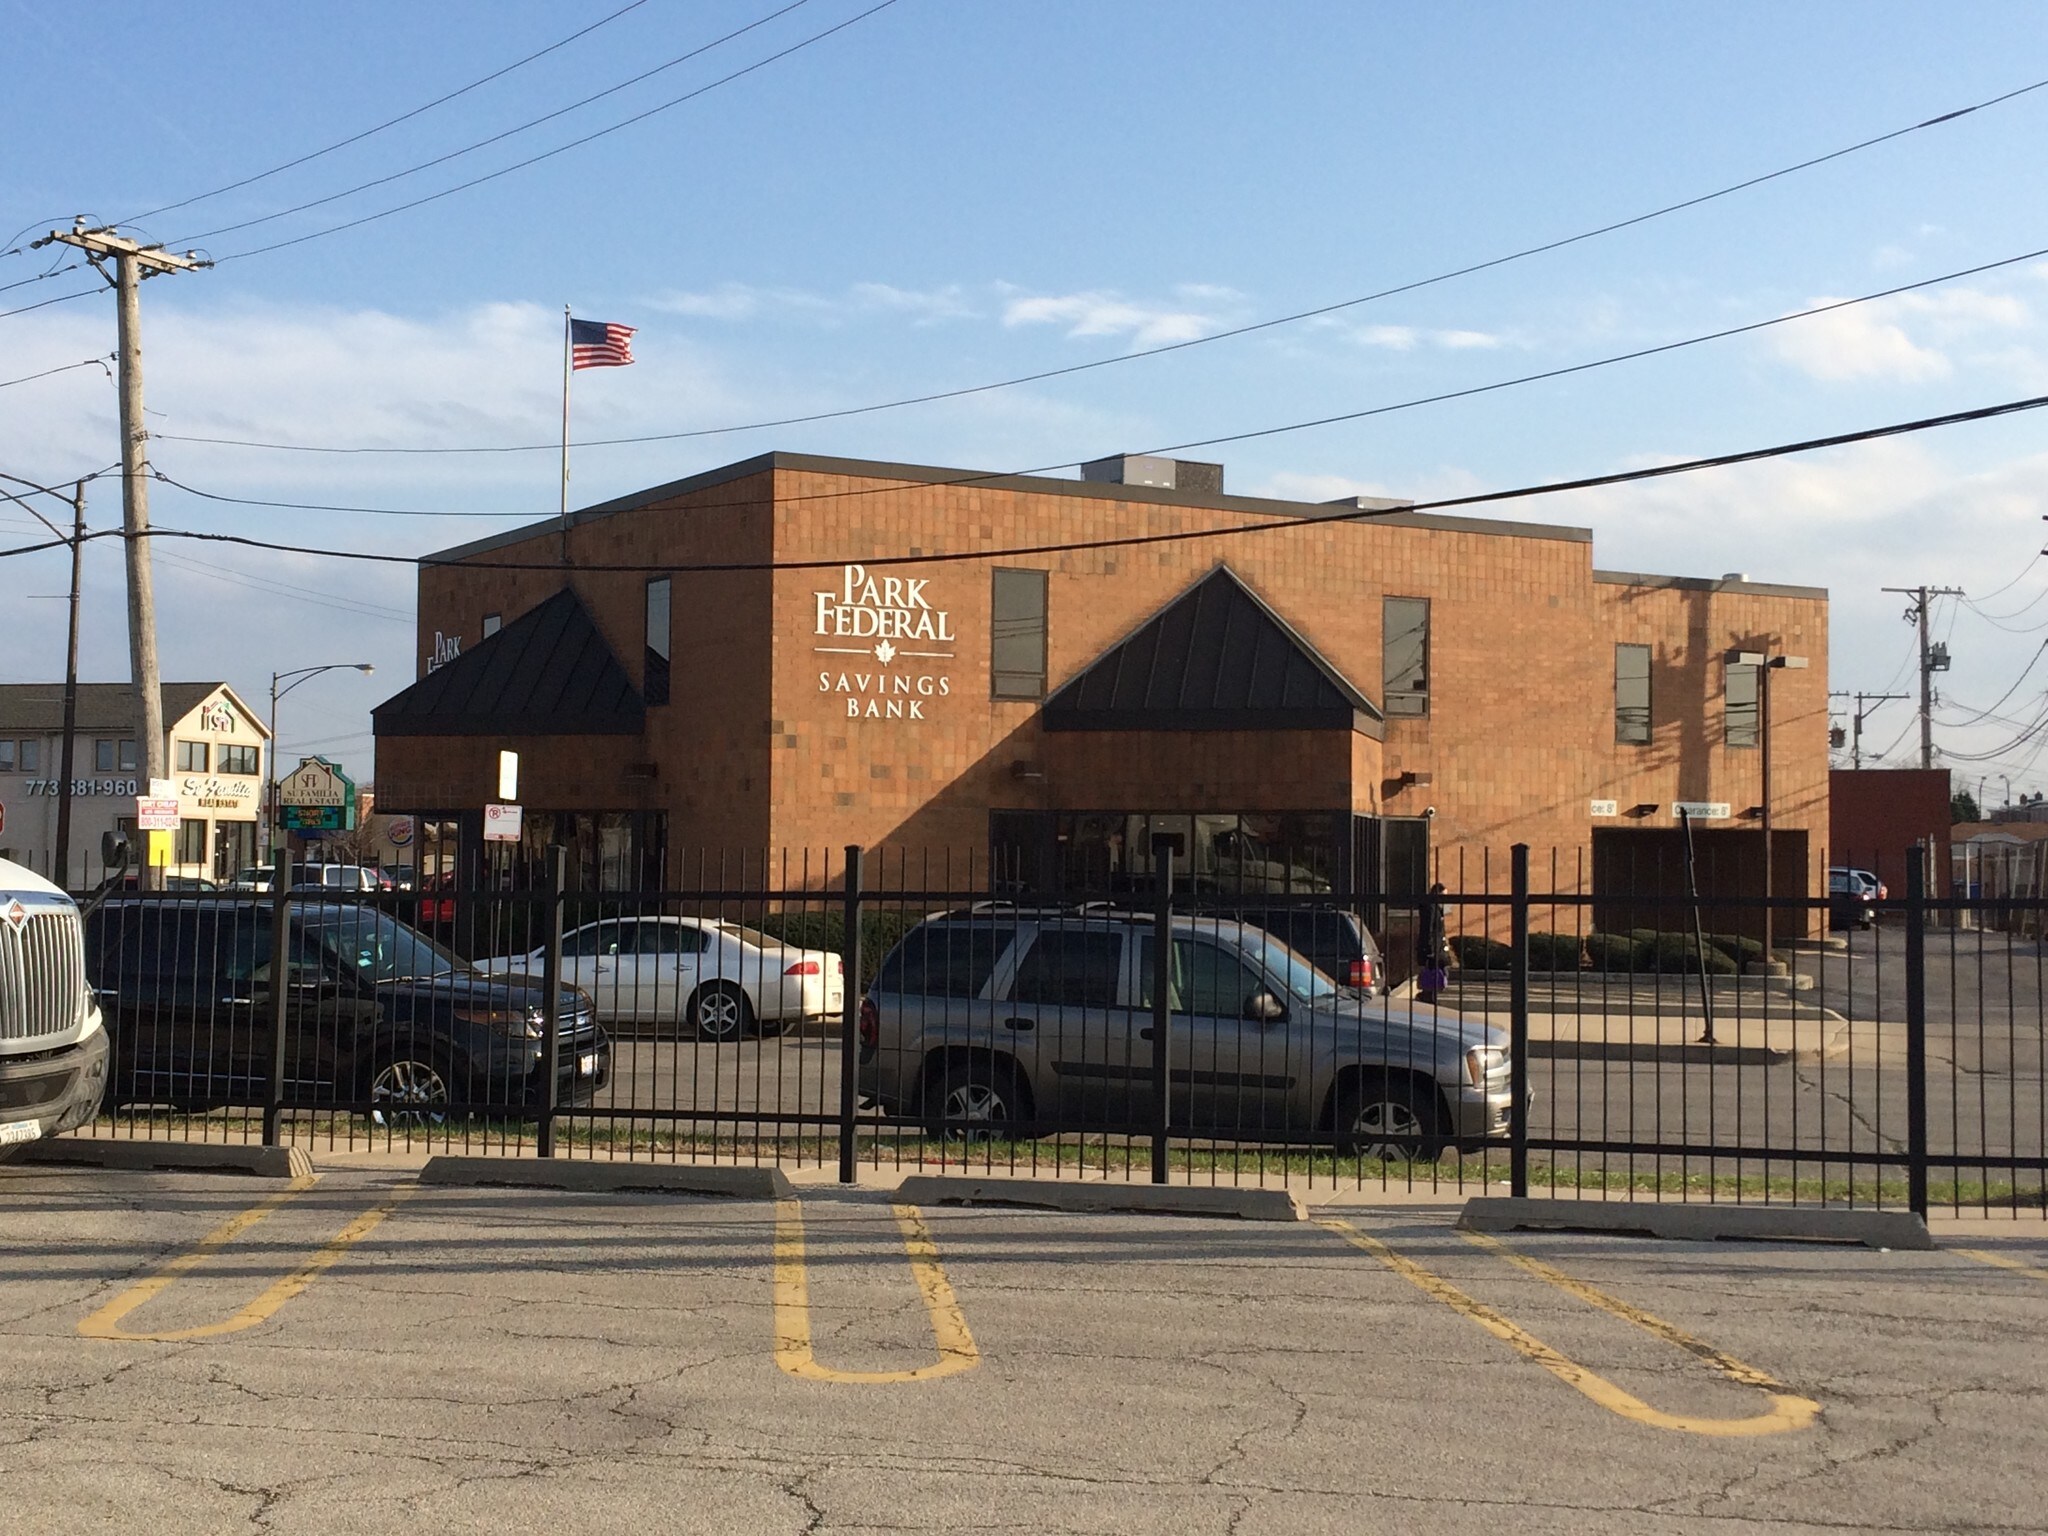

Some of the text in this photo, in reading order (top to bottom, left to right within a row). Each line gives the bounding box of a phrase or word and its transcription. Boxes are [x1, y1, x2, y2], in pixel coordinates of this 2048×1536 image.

[842, 564, 933, 609] PARK
[813, 591, 955, 641] FEDERAL
[434, 631, 462, 664] PARK
[819, 671, 950, 696] SAVINGS
[847, 697, 925, 719] BANK
[287, 788, 338, 797] SU FAMILIA
[1675, 805, 1719, 815] Carance:
